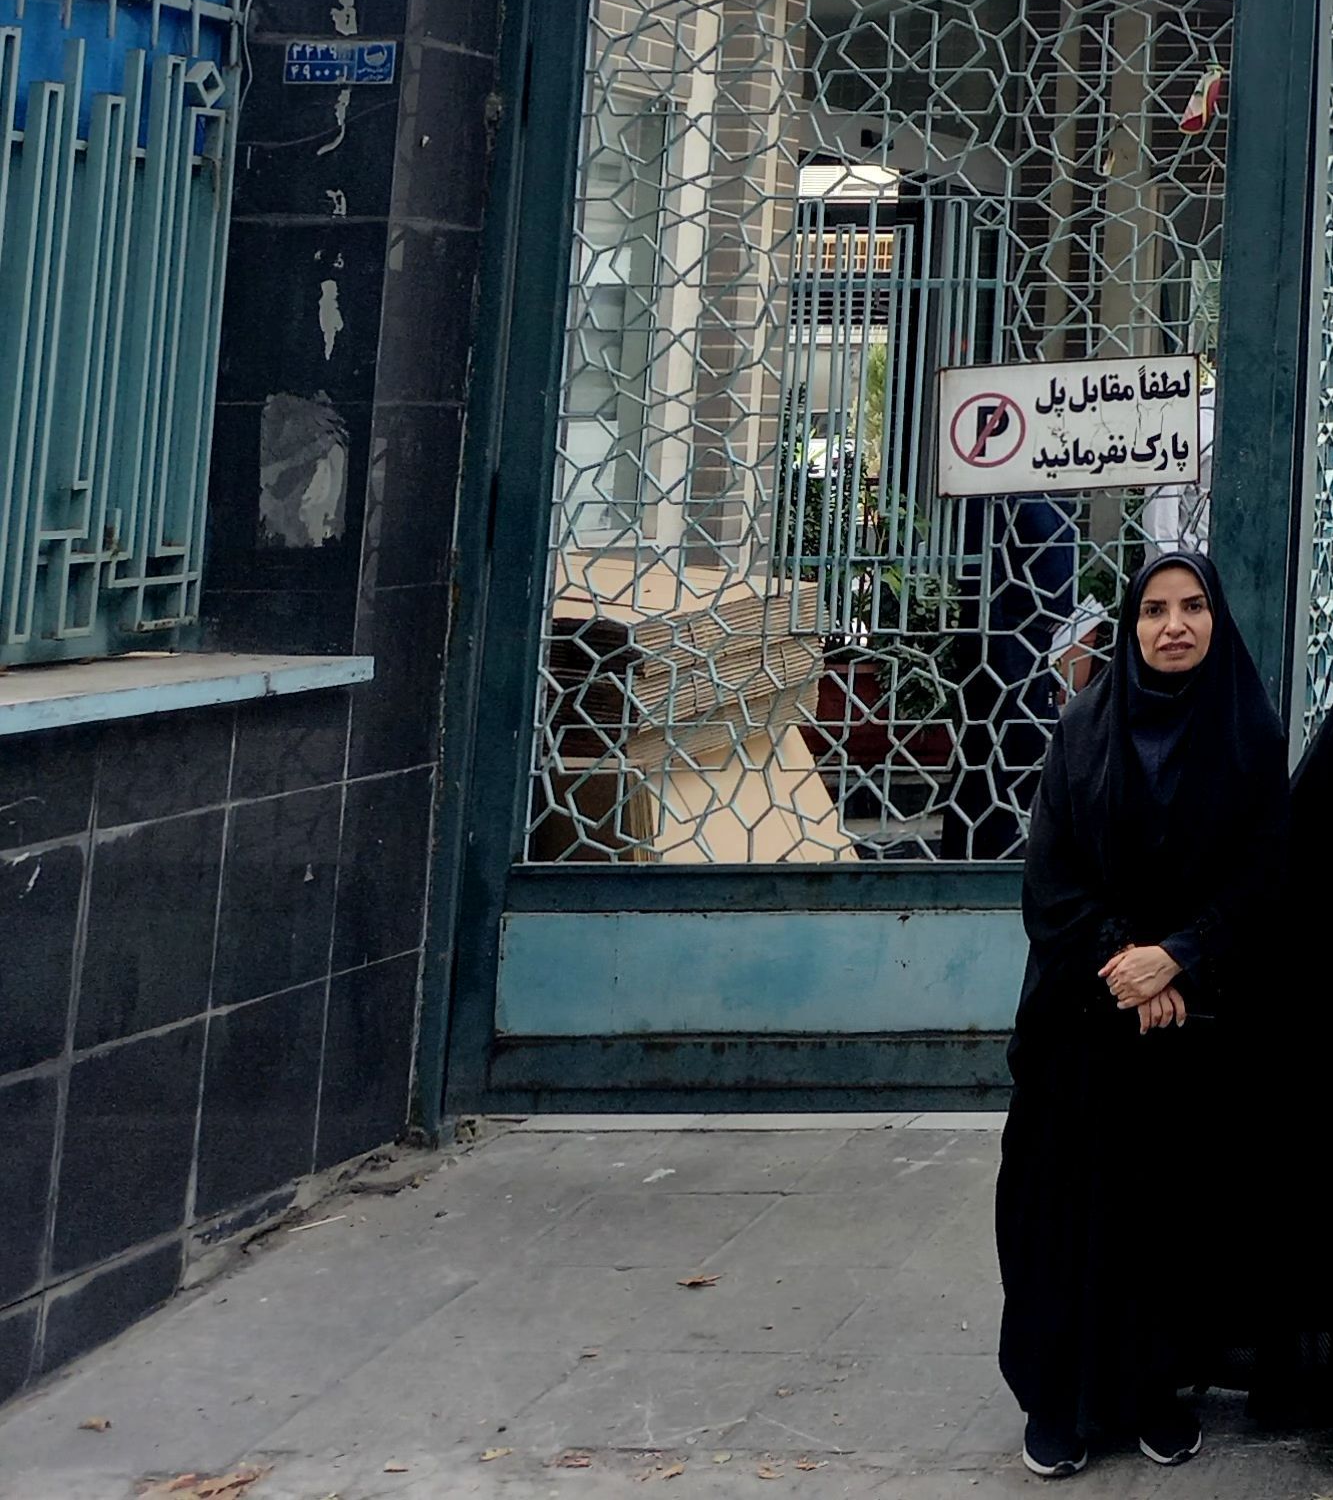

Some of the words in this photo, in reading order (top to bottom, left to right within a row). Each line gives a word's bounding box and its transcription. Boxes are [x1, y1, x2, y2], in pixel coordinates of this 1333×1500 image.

[1035, 377, 1066, 417] پل
[1069, 373, 1135, 413] مقابل
[1131, 432, 1190, 472] پارک
